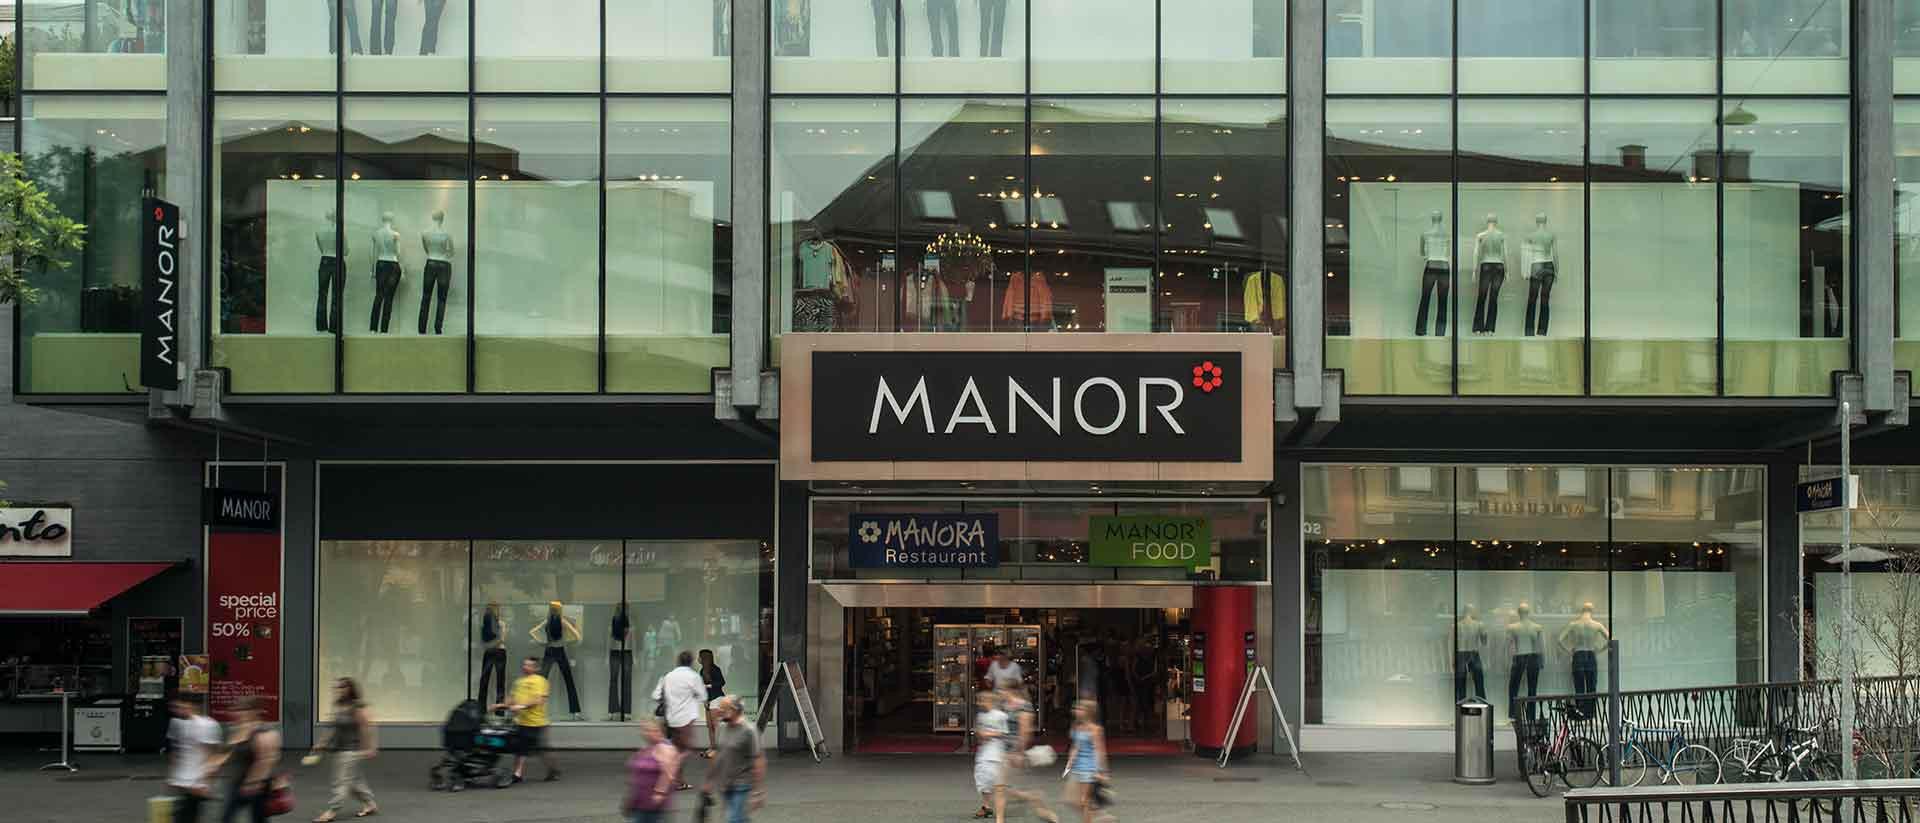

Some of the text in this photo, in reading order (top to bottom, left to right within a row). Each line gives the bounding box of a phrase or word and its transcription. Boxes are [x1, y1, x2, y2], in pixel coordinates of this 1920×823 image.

[158, 224, 174, 365] MANOR
[868, 375, 1185, 436] MANOR
[221, 495, 271, 520] MANOR
[885, 518, 985, 550] MANORA
[1105, 522, 1195, 540] MANOR
[885, 549, 987, 564] Restaurant
[1132, 542, 1196, 560] FOOD
[219, 592, 277, 609] special
[235, 607, 277, 620] price
[212, 622, 250, 637] 50%
